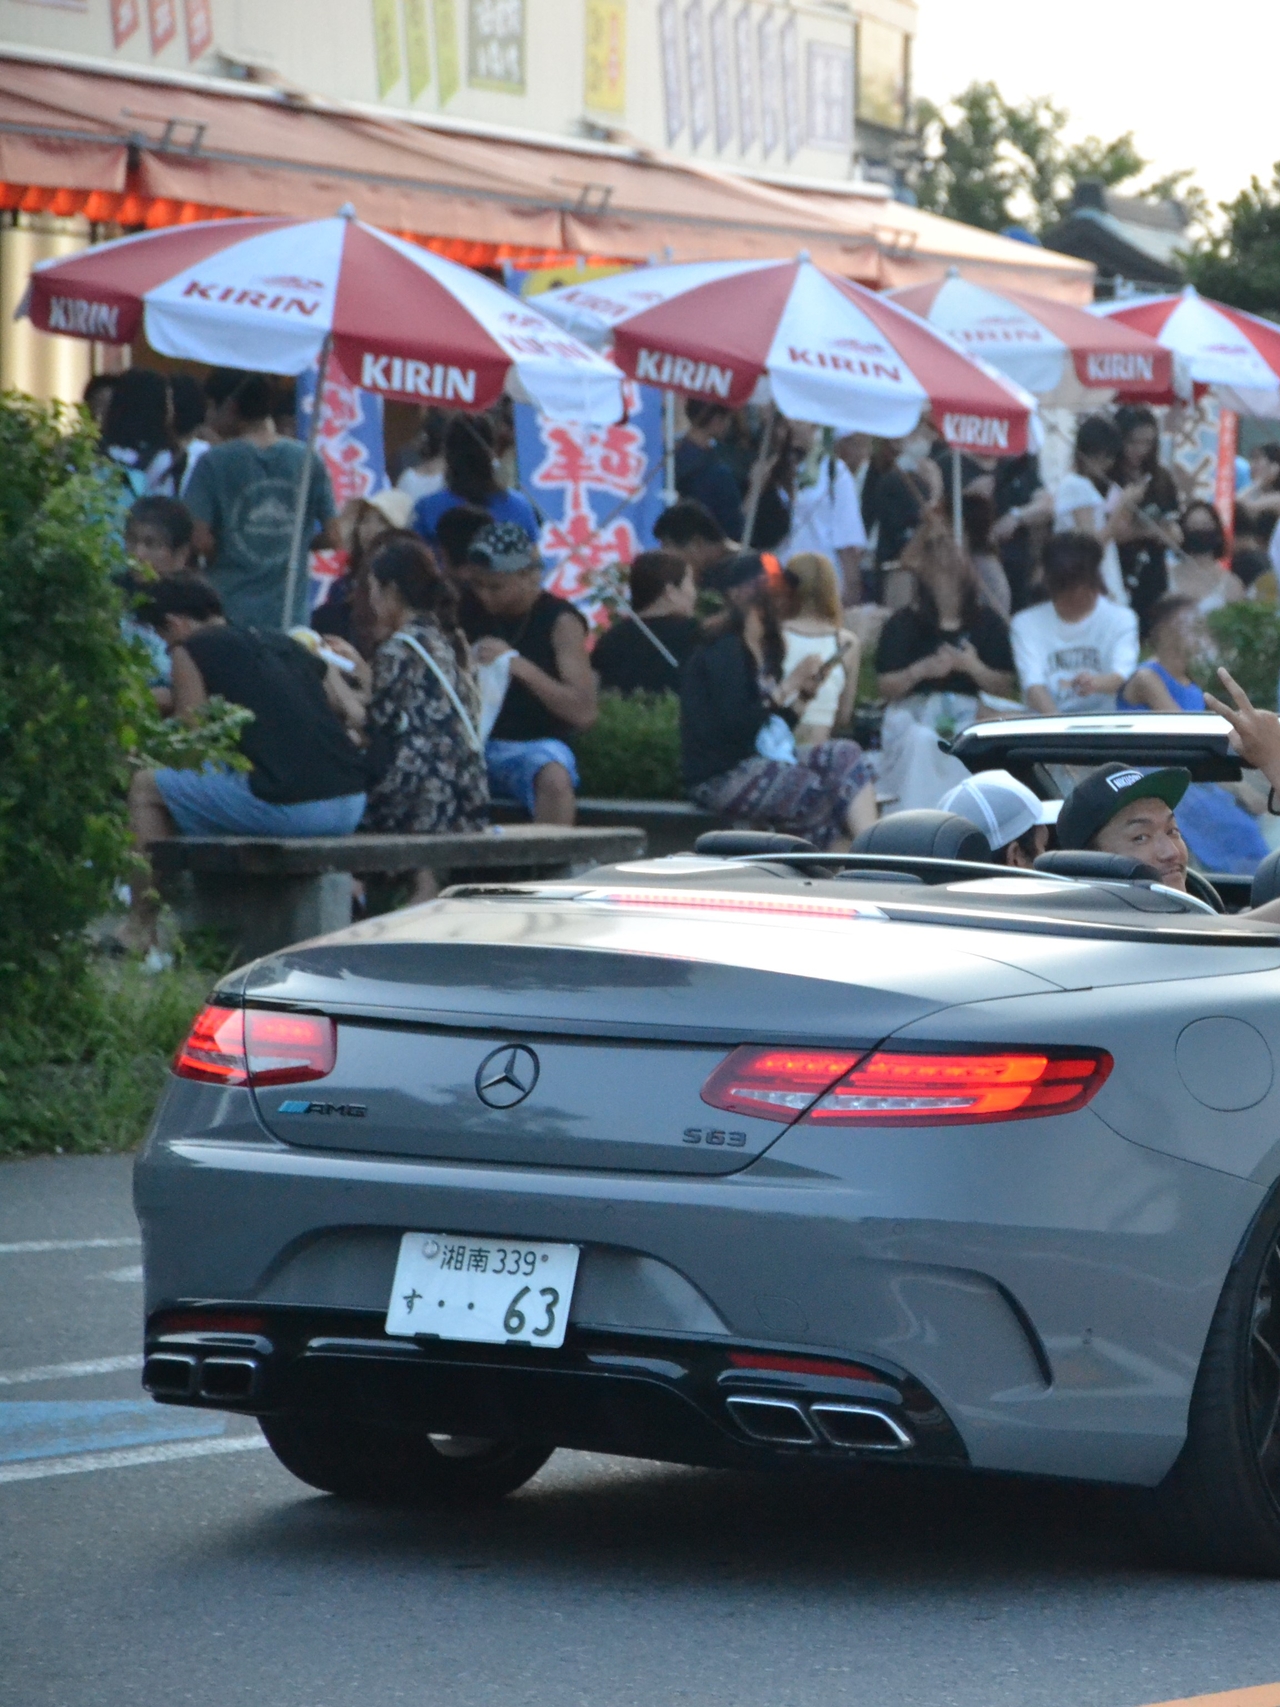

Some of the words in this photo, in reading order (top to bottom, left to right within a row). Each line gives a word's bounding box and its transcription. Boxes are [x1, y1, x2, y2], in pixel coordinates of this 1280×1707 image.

[49, 295, 121, 339] KIRIN
[182, 279, 321, 318] KIRIN
[361, 352, 477, 404] KIRIN
[637, 347, 734, 399] KIRIN
[788, 344, 902, 382] KIRIN
[1087, 352, 1154, 382] KIRIN
[943, 411, 1010, 449] KIRIN
[304, 1101, 368, 1118] AMG
[503, 1285, 560, 1338] 63
